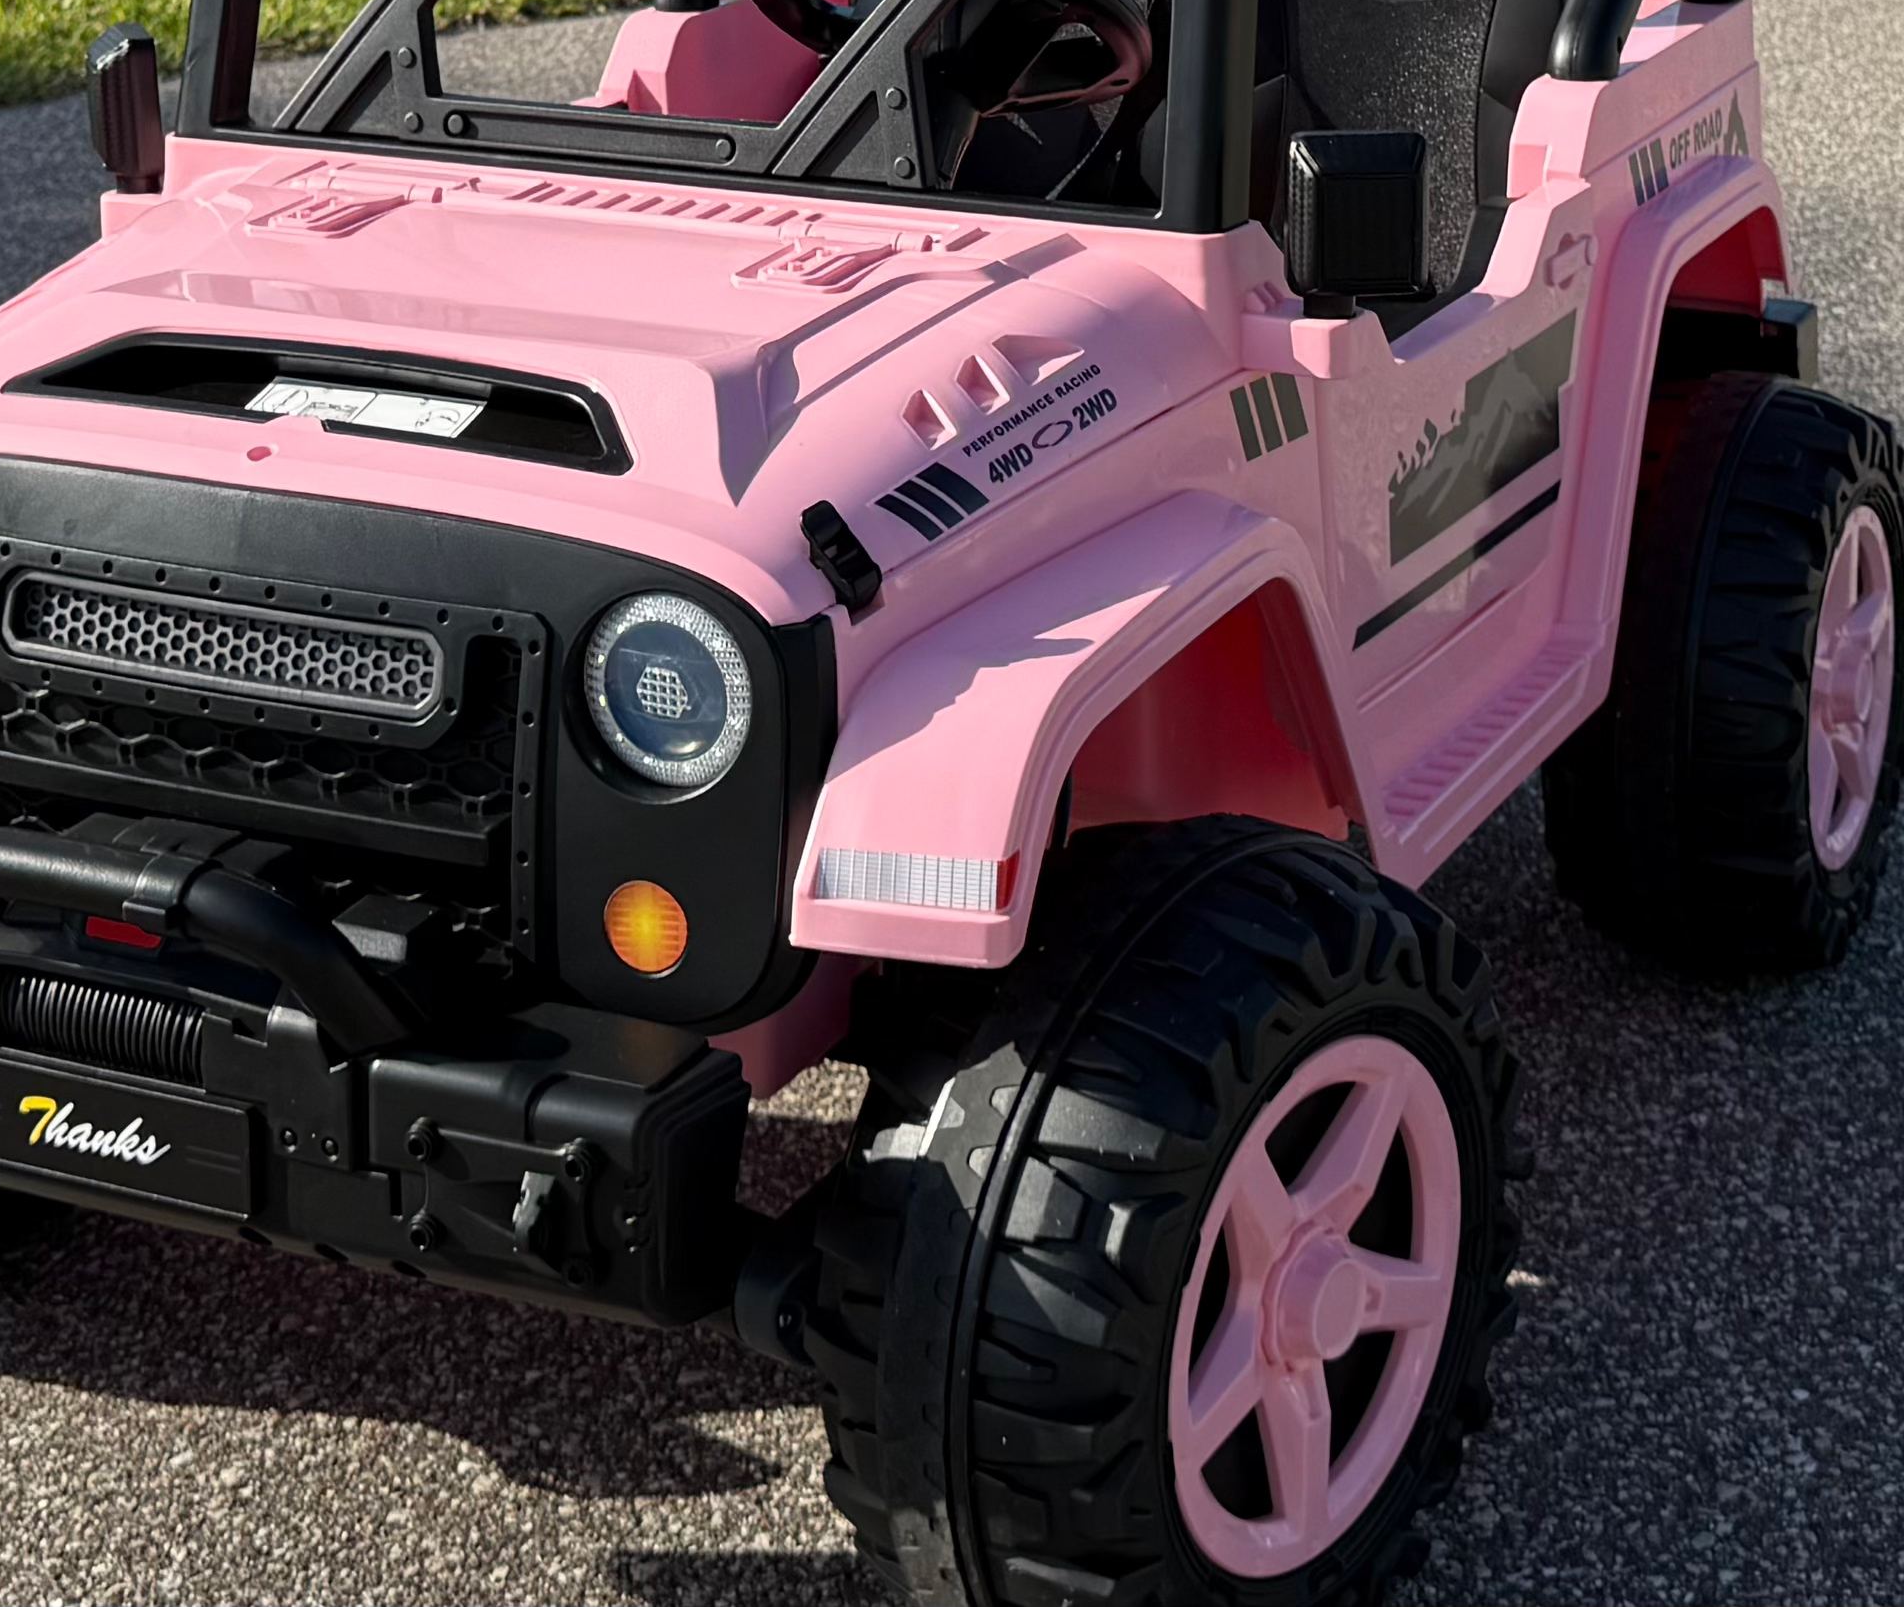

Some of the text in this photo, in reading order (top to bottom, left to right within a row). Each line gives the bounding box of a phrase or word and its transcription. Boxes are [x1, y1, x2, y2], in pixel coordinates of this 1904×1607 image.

[1669, 107, 1722, 170] OFF ROAD
[962, 392, 1055, 457] PERFORMANCE
[988, 388, 1118, 484] 4WD 2WD
[19, 1096, 172, 1165] Thanks
